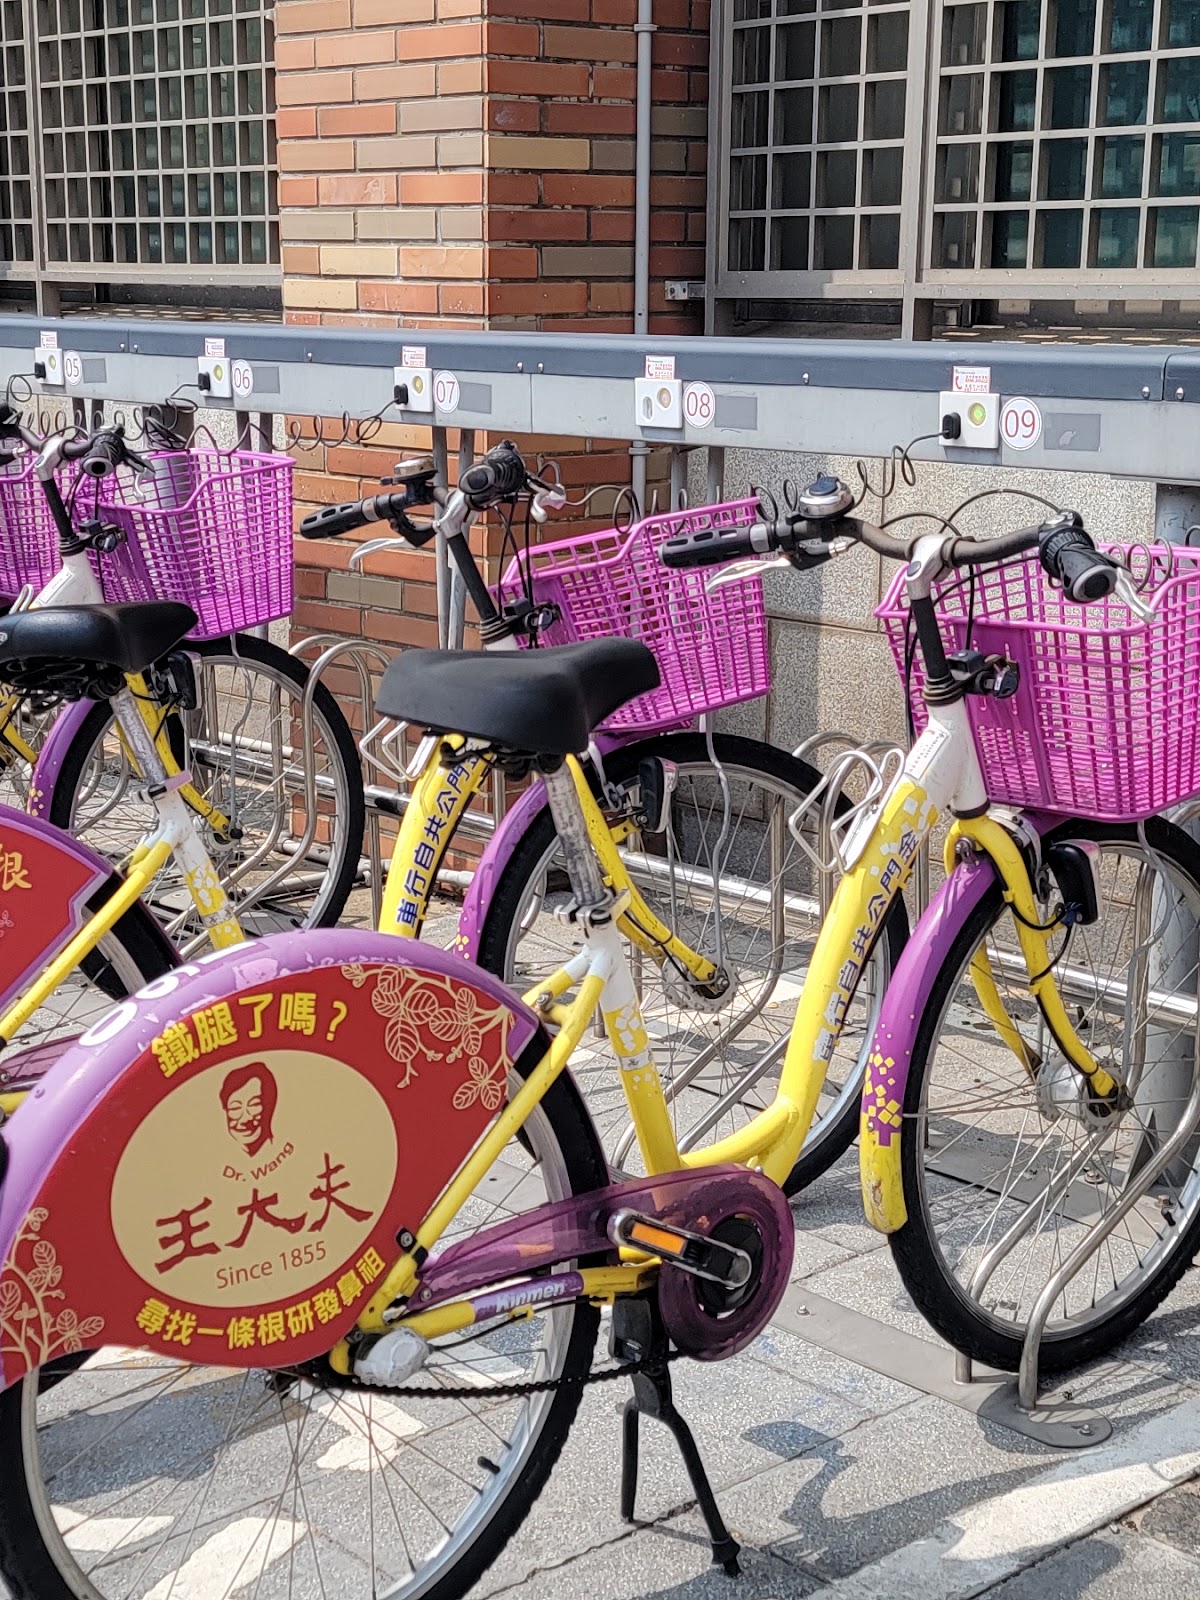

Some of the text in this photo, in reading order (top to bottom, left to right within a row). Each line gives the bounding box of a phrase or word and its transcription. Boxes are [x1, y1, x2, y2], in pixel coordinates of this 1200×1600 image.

[65, 357, 80, 378] 05
[233, 367, 250, 389] 06
[436, 380, 456, 404] 07
[687, 391, 711, 418] 08
[1004, 409, 1036, 438] 09
[222, 1141, 294, 1182] Dr. Wang
[154, 1152, 374, 1275] 王大夫
[216, 1240, 326, 1289] Since 1855
[135, 1246, 387, 1350] 尋找一條根研發鼻祖
[495, 1282, 566, 1313] Kinmen
